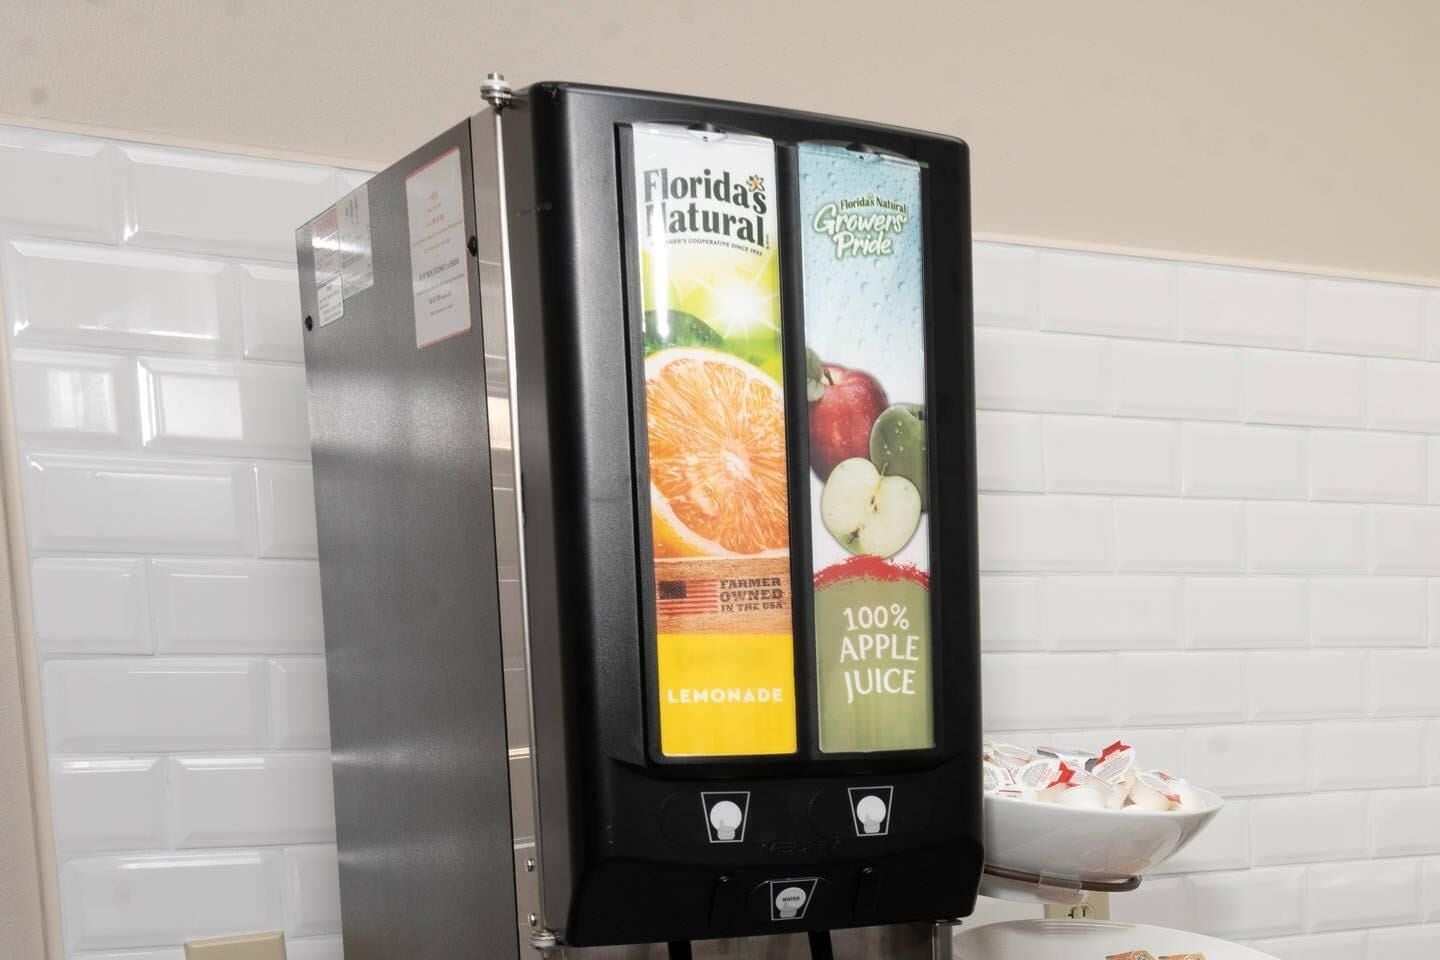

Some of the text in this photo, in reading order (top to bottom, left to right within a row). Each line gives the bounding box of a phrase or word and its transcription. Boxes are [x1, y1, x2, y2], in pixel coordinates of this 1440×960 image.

[876, 197, 907, 213] Natural
[646, 202, 765, 247] Natural
[833, 230, 891, 258] Pride
[720, 577, 781, 589] FARMER
[720, 589, 783, 602] OWNED
[721, 601, 783, 612] IN THE USA
[843, 603, 909, 631] 100%
[840, 633, 919, 663] APPLE
[667, 688, 783, 704] LEMONADE
[844, 668, 916, 704] JUICE
